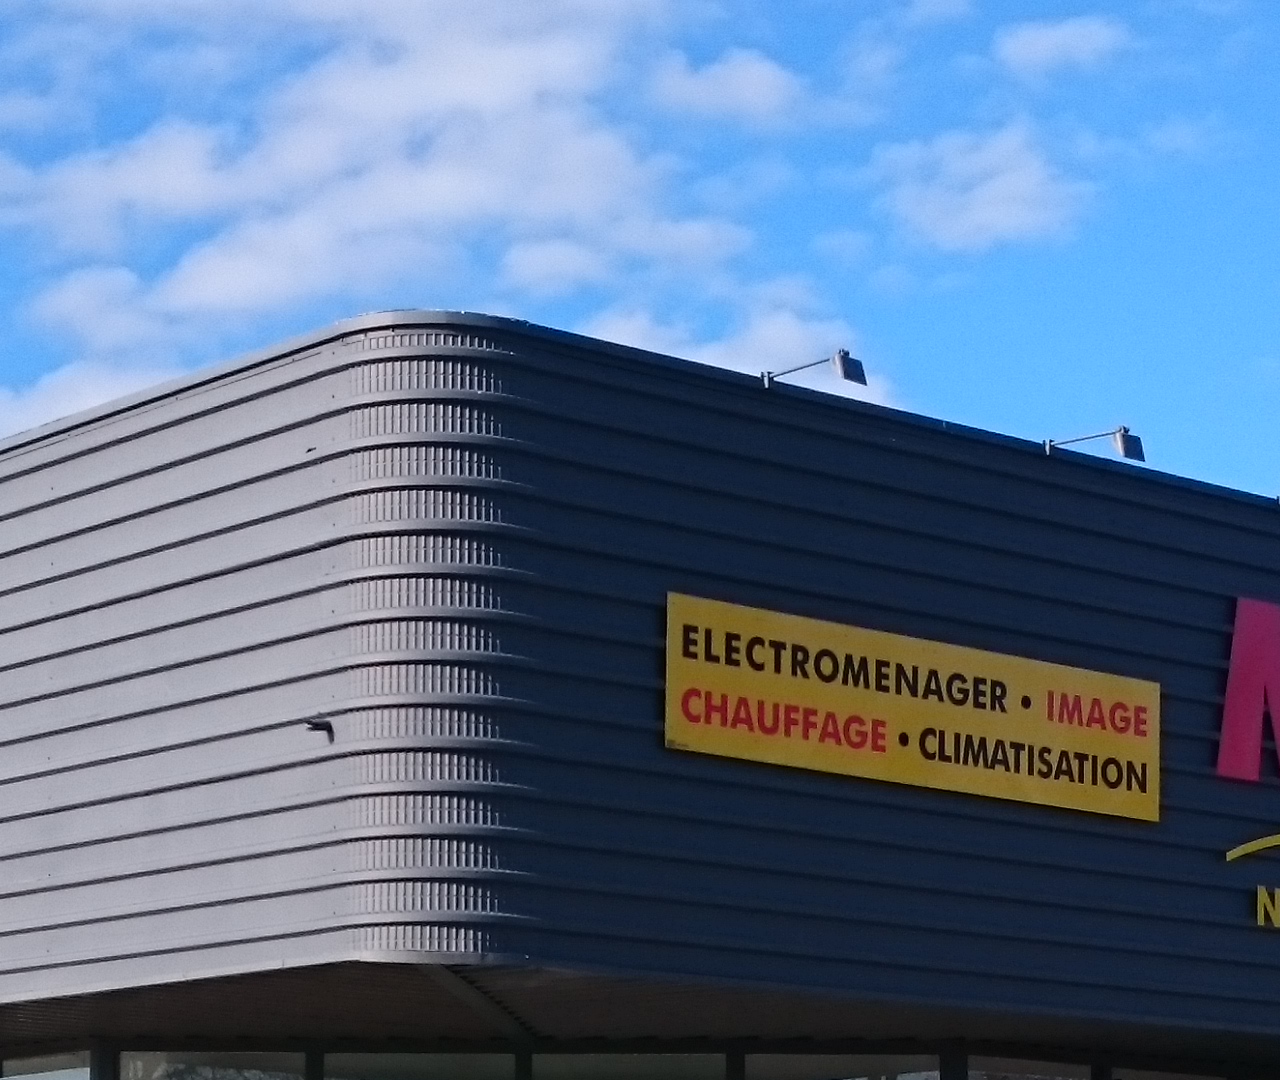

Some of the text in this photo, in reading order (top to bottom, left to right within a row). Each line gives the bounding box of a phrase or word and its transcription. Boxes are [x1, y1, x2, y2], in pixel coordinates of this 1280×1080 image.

[680, 622, 1149, 738] ELECTROMENAGER IMAGE
[680, 687, 1149, 795] CHAUFFAGE CLIMATISATION
